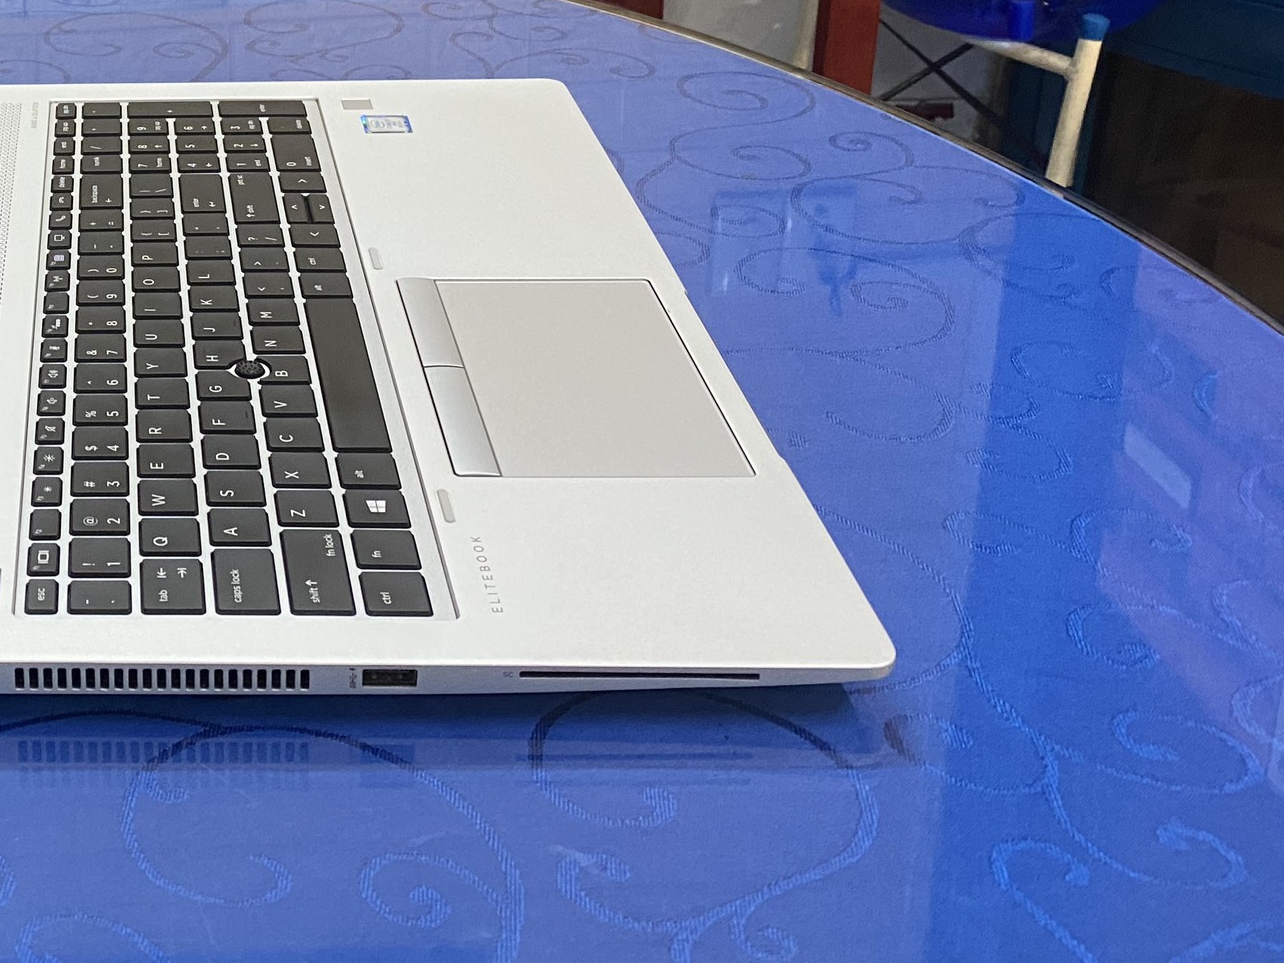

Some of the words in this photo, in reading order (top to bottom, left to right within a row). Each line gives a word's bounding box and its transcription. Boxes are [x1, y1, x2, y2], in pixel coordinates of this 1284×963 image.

[209, 385, 222, 393] G
[284, 471, 300, 479] X
[355, 470, 365, 479] alt
[220, 489, 235, 498] S
[152, 494, 166, 506] W
[290, 509, 306, 518] Z
[83, 516, 98, 526] @
[223, 527, 238, 537] A
[153, 537, 168, 546] Q
[323, 534, 333, 549] lock
[325, 549, 336, 557] fn
[371, 550, 382, 558] fn
[230, 568, 240, 585] lock
[470, 536, 504, 613] ELITEBOOK
[159, 589, 168, 601] tab
[234, 585, 242, 603] caps
[310, 587, 321, 604] shift
[380, 591, 392, 605] ctrl
